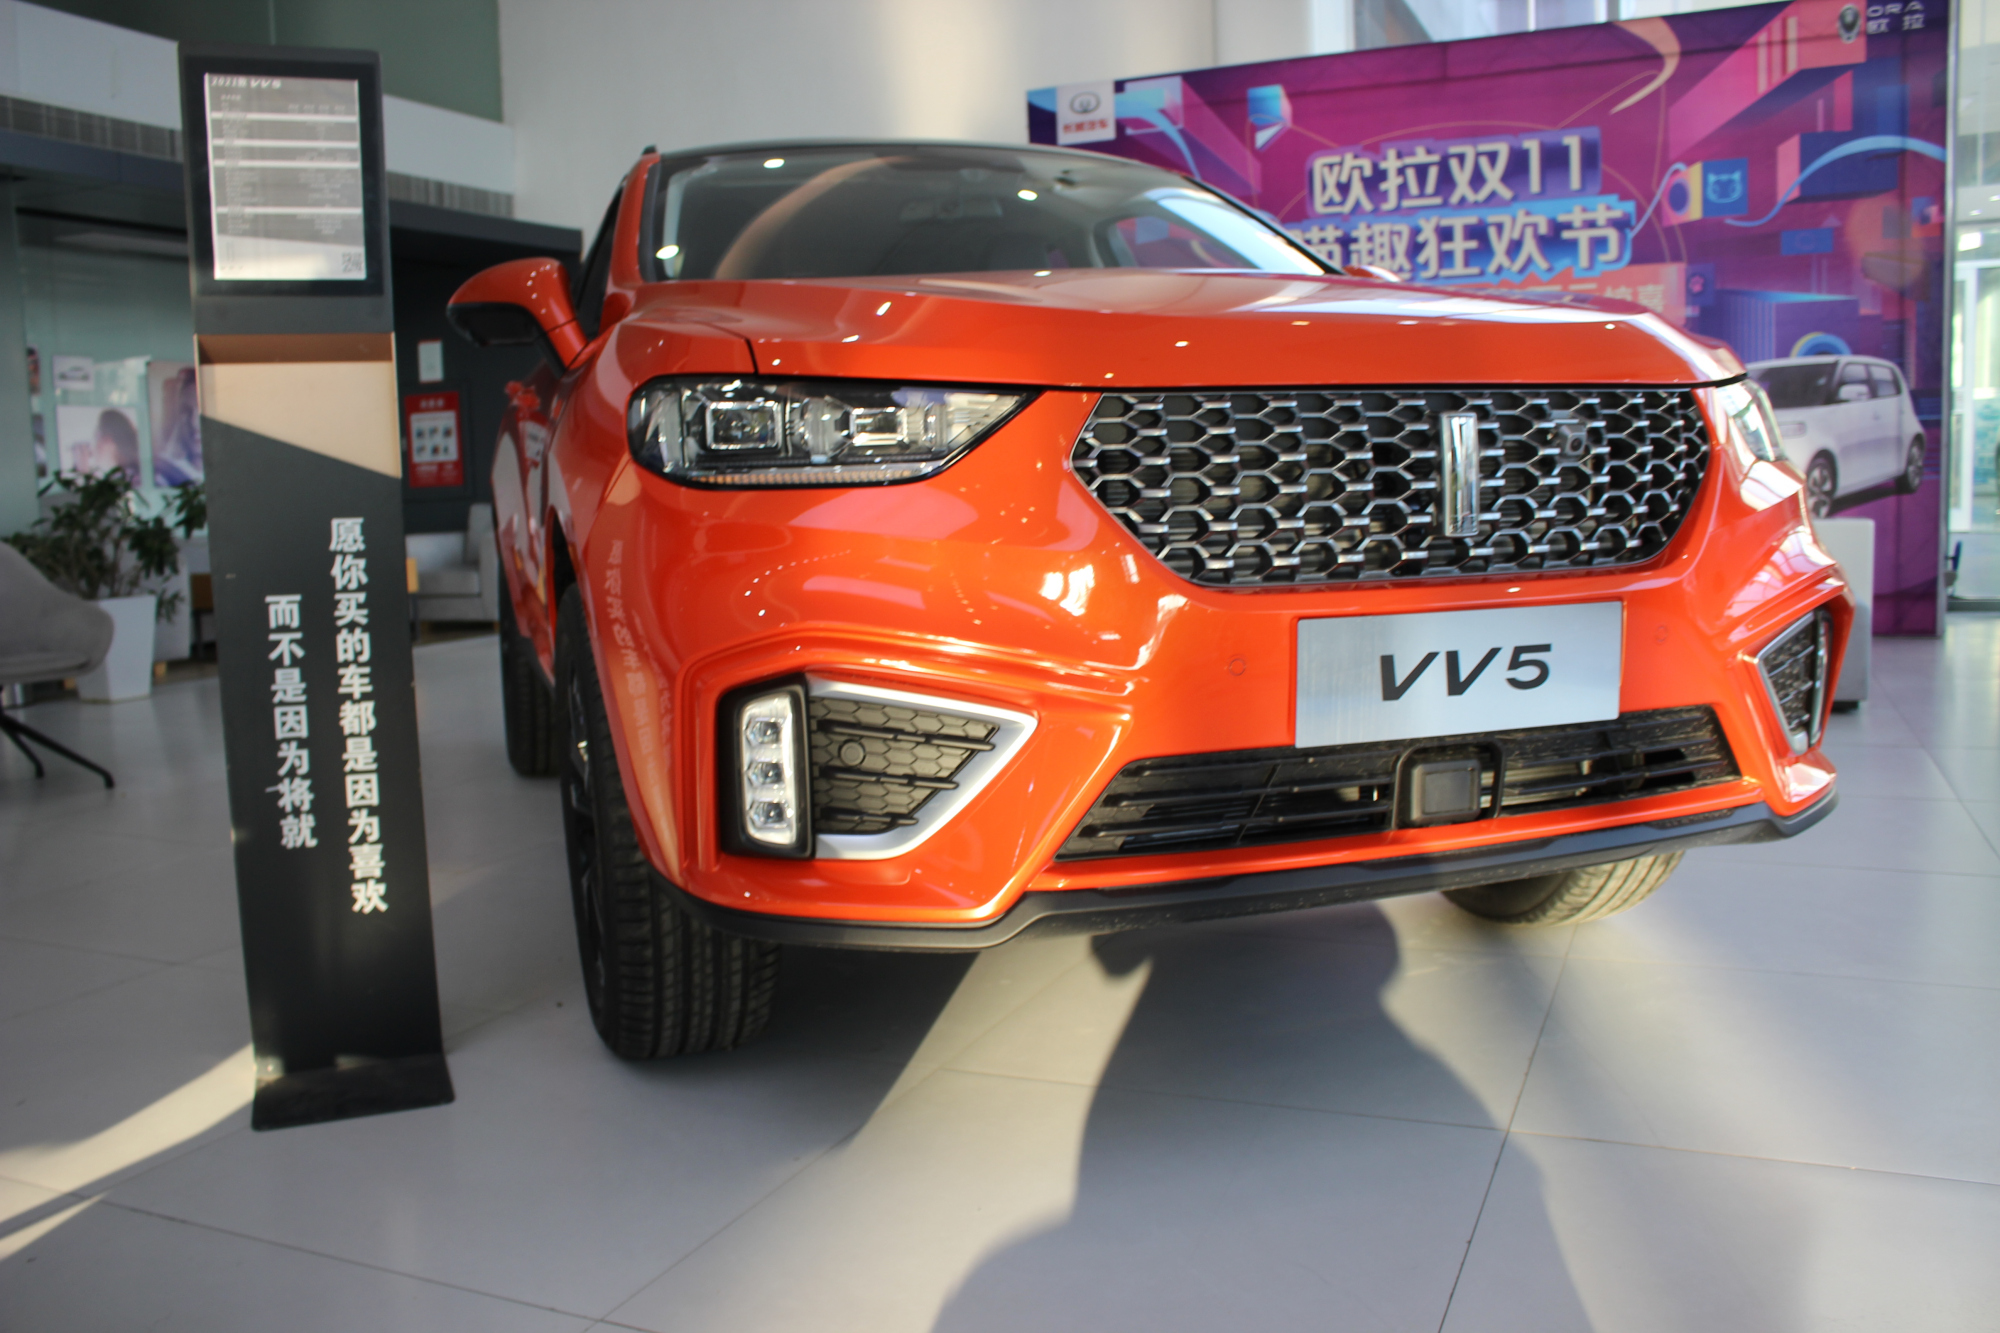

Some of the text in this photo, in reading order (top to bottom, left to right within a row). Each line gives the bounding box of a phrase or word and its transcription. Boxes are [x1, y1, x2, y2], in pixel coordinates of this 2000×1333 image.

[1866, 1, 1924, 18] ORA
[1312, 134, 1582, 214] 欧拉双11
[1380, 643, 1552, 701] VV5
[265, 593, 317, 849] 而不是因为将就
[329, 517, 388, 914] 愿你买的车都是因为喜欢
